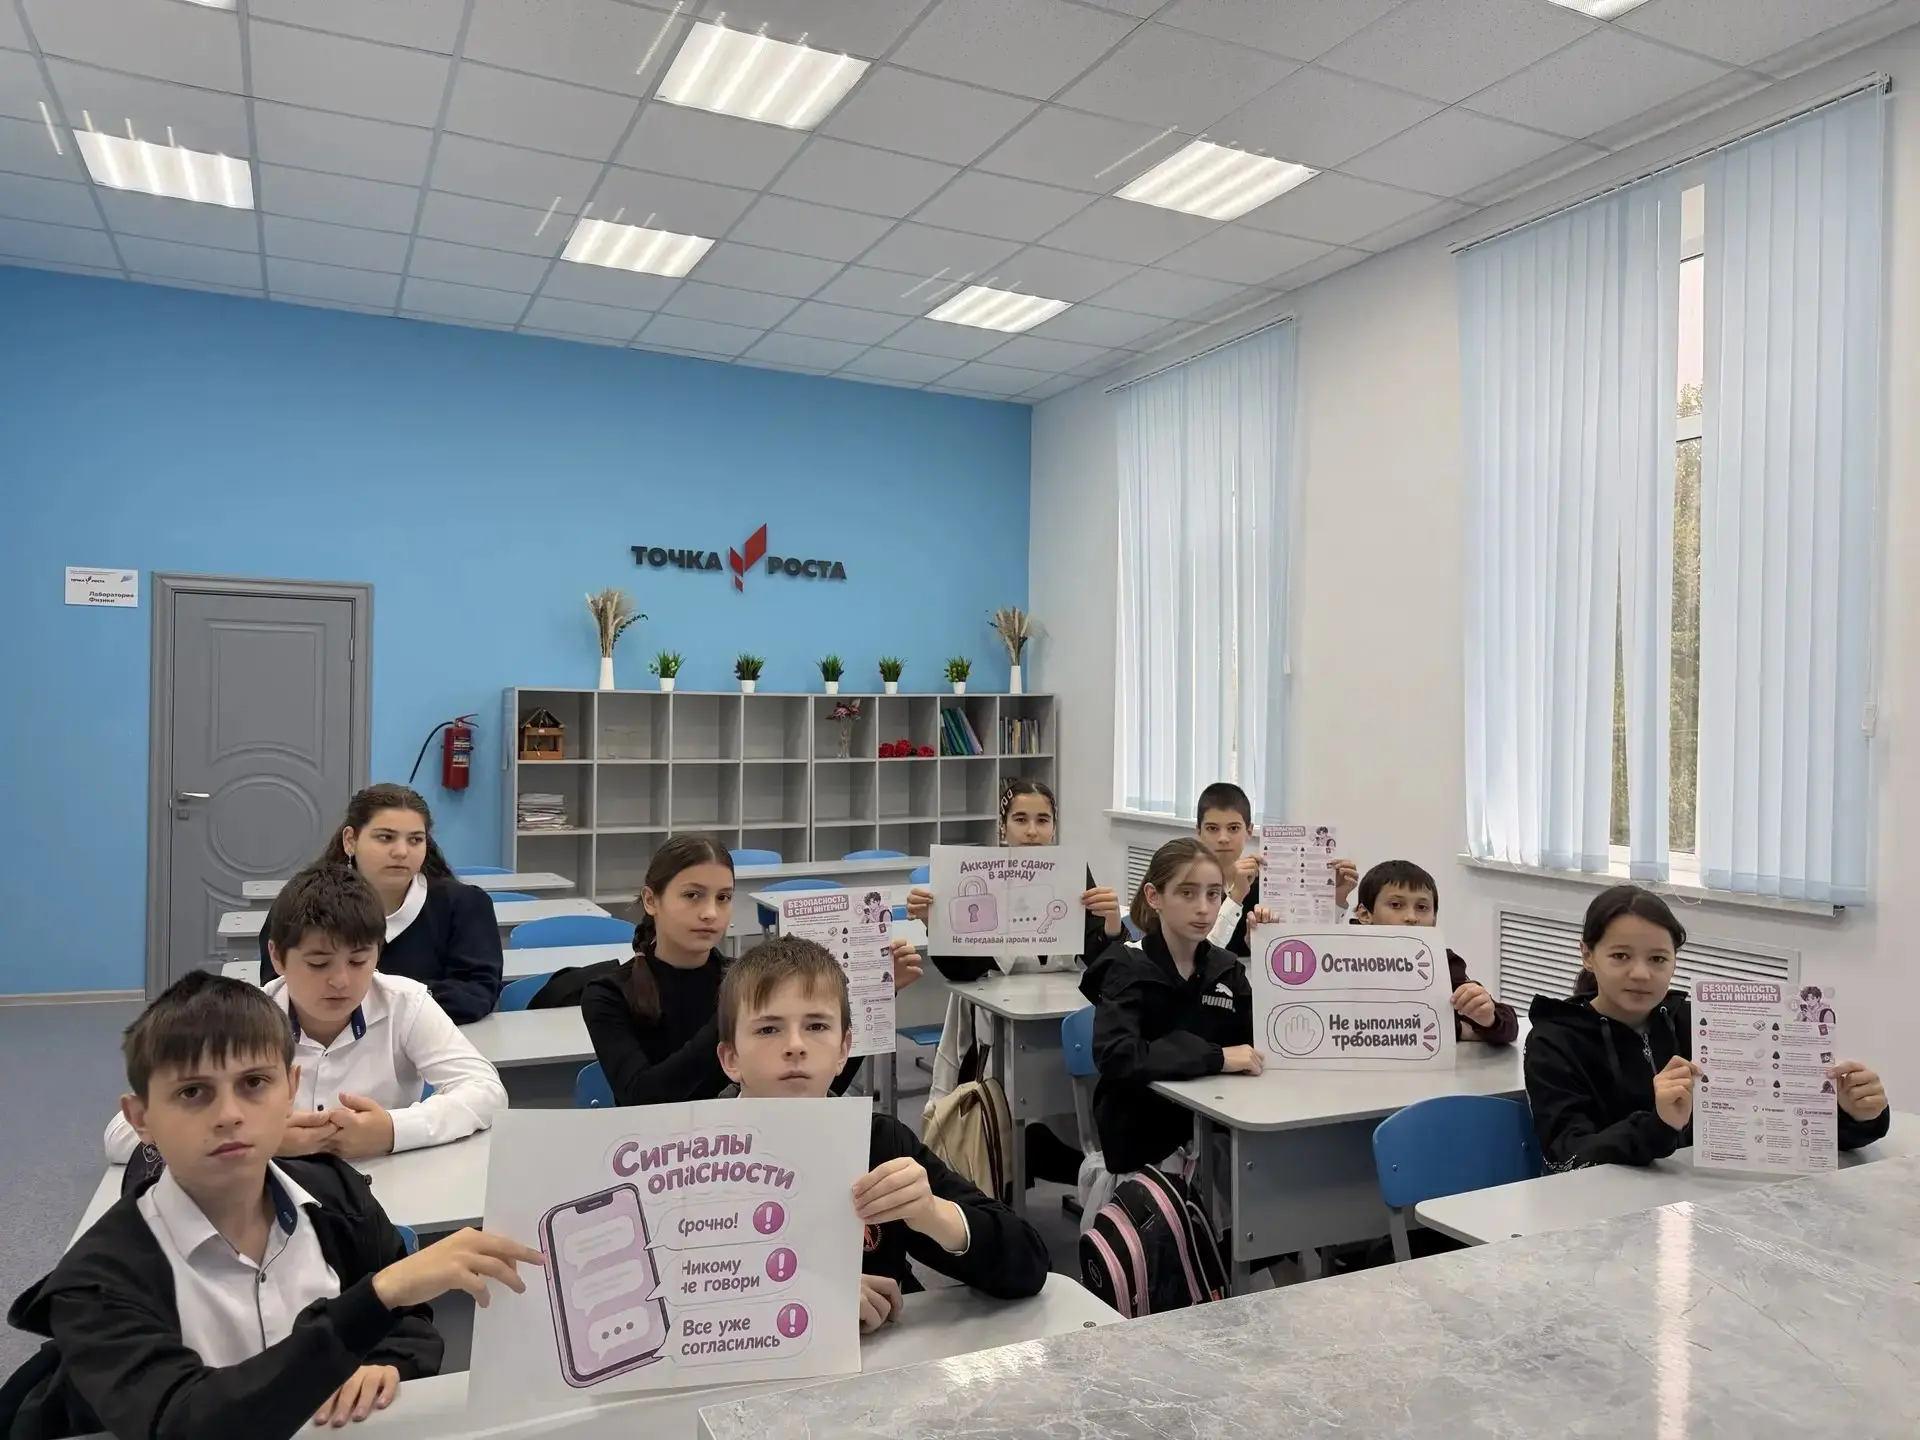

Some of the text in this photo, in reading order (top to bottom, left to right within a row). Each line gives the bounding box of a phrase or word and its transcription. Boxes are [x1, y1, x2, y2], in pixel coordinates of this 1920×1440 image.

[631, 545, 847, 580] ТОЧКА РОСТА
[960, 859, 1005, 874] Аккаунт
[1021, 859, 1055, 871] сдают
[988, 869, 1036, 882] в аренду
[788, 896, 846, 909] БЕЗОПАСНОСТЬ
[794, 907, 813, 915] СЕТИ
[813, 902, 848, 913] ИНТЕРНЕТ
[952, 935, 962, 944] Не
[965, 936, 1004, 944] передавай
[1006, 936, 1030, 945] ароли
[1039, 935, 1058, 944] коды
[1321, 953, 1414, 973] Остановись
[1702, 983, 1777, 993] БЕЗОПАСНОСТЬ
[1202, 995, 1233, 1010] PUMA
[1702, 992, 1778, 1001] В СЕТИ ИНТЕРНЕТ
[1329, 1014, 1349, 1030] Не
[1332, 1031, 1417, 1051] требования
[613, 1133, 753, 1177] Сигналы
[648, 1161, 795, 1195] опасности
[704, 1275, 760, 1293] говори
[683, 1317, 751, 1337] Все уже
[681, 1335, 780, 1356] согласились
